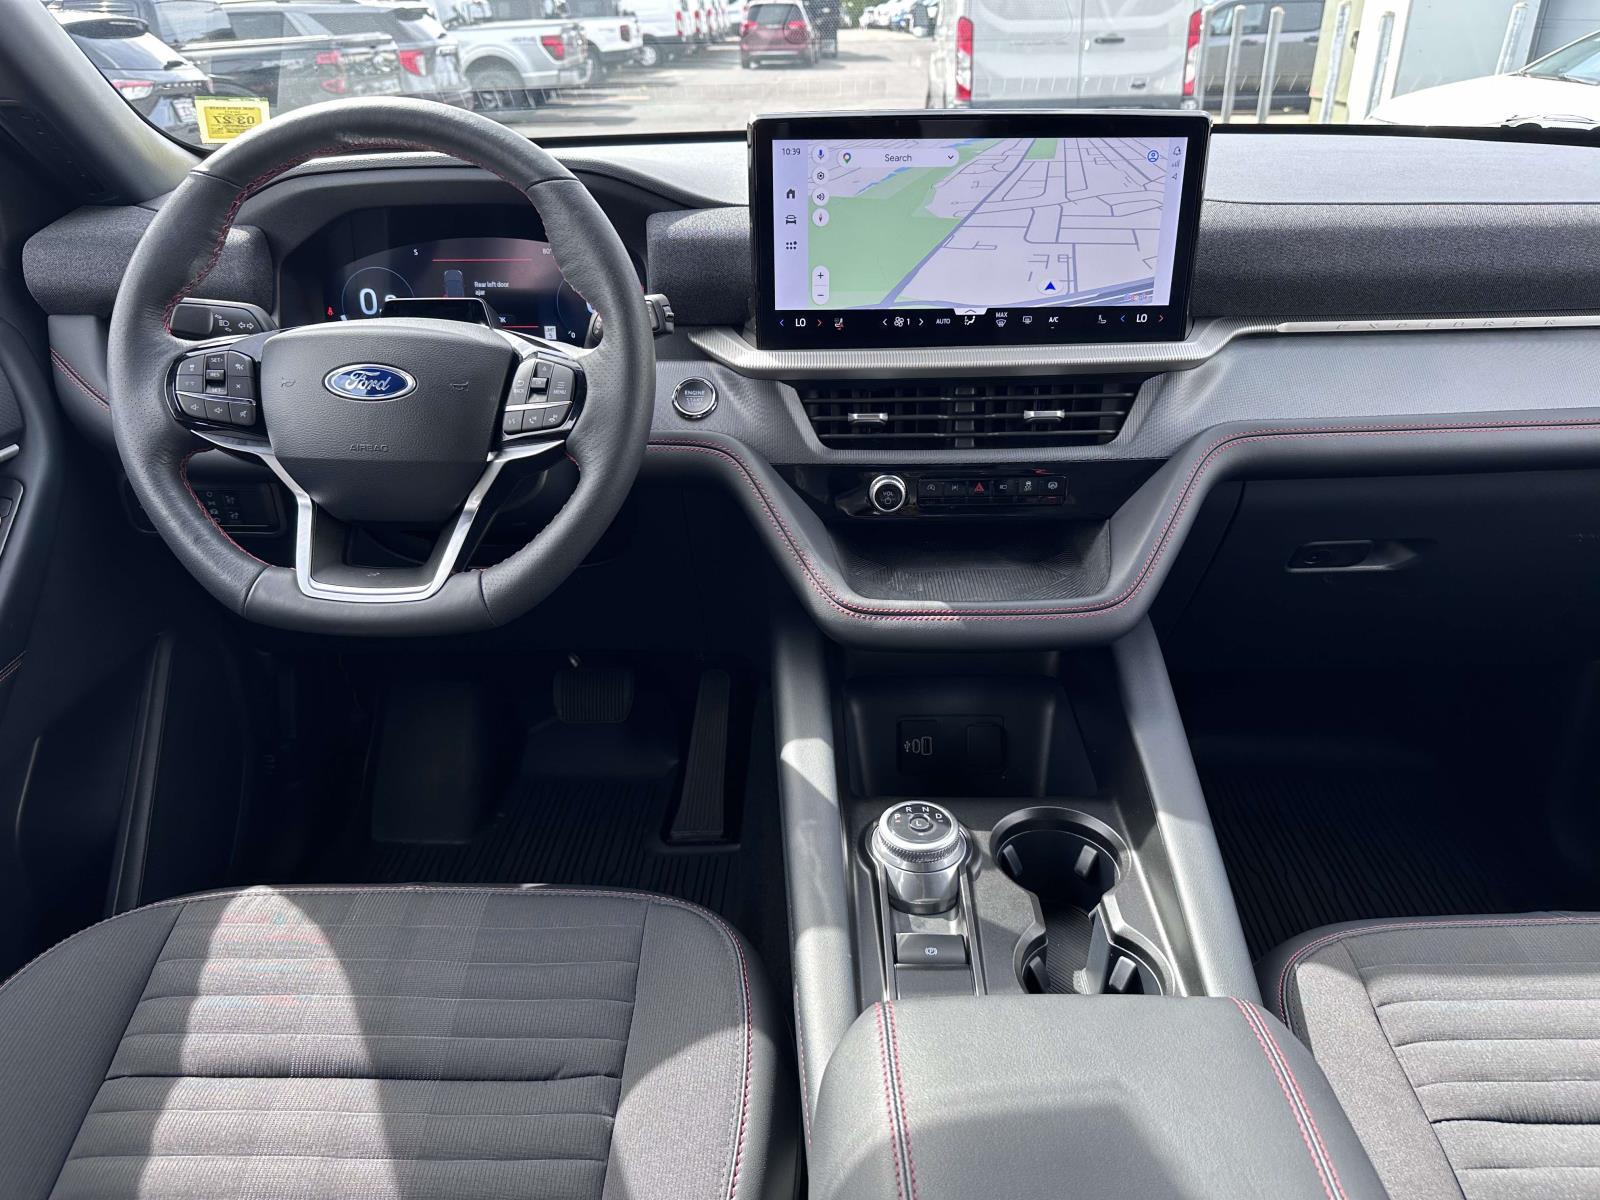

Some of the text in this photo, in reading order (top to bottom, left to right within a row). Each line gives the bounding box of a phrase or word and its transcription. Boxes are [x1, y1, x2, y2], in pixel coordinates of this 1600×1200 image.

[782, 148, 801, 156] 10:39
[884, 153, 913, 162] Search
[475, 289, 486, 297] ajar
[359, 287, 378, 315] 0
[795, 318, 807, 327] LO
[1136, 313, 1148, 323] LO
[345, 371, 390, 392] Ford
[349, 443, 389, 452] AIRBAG
